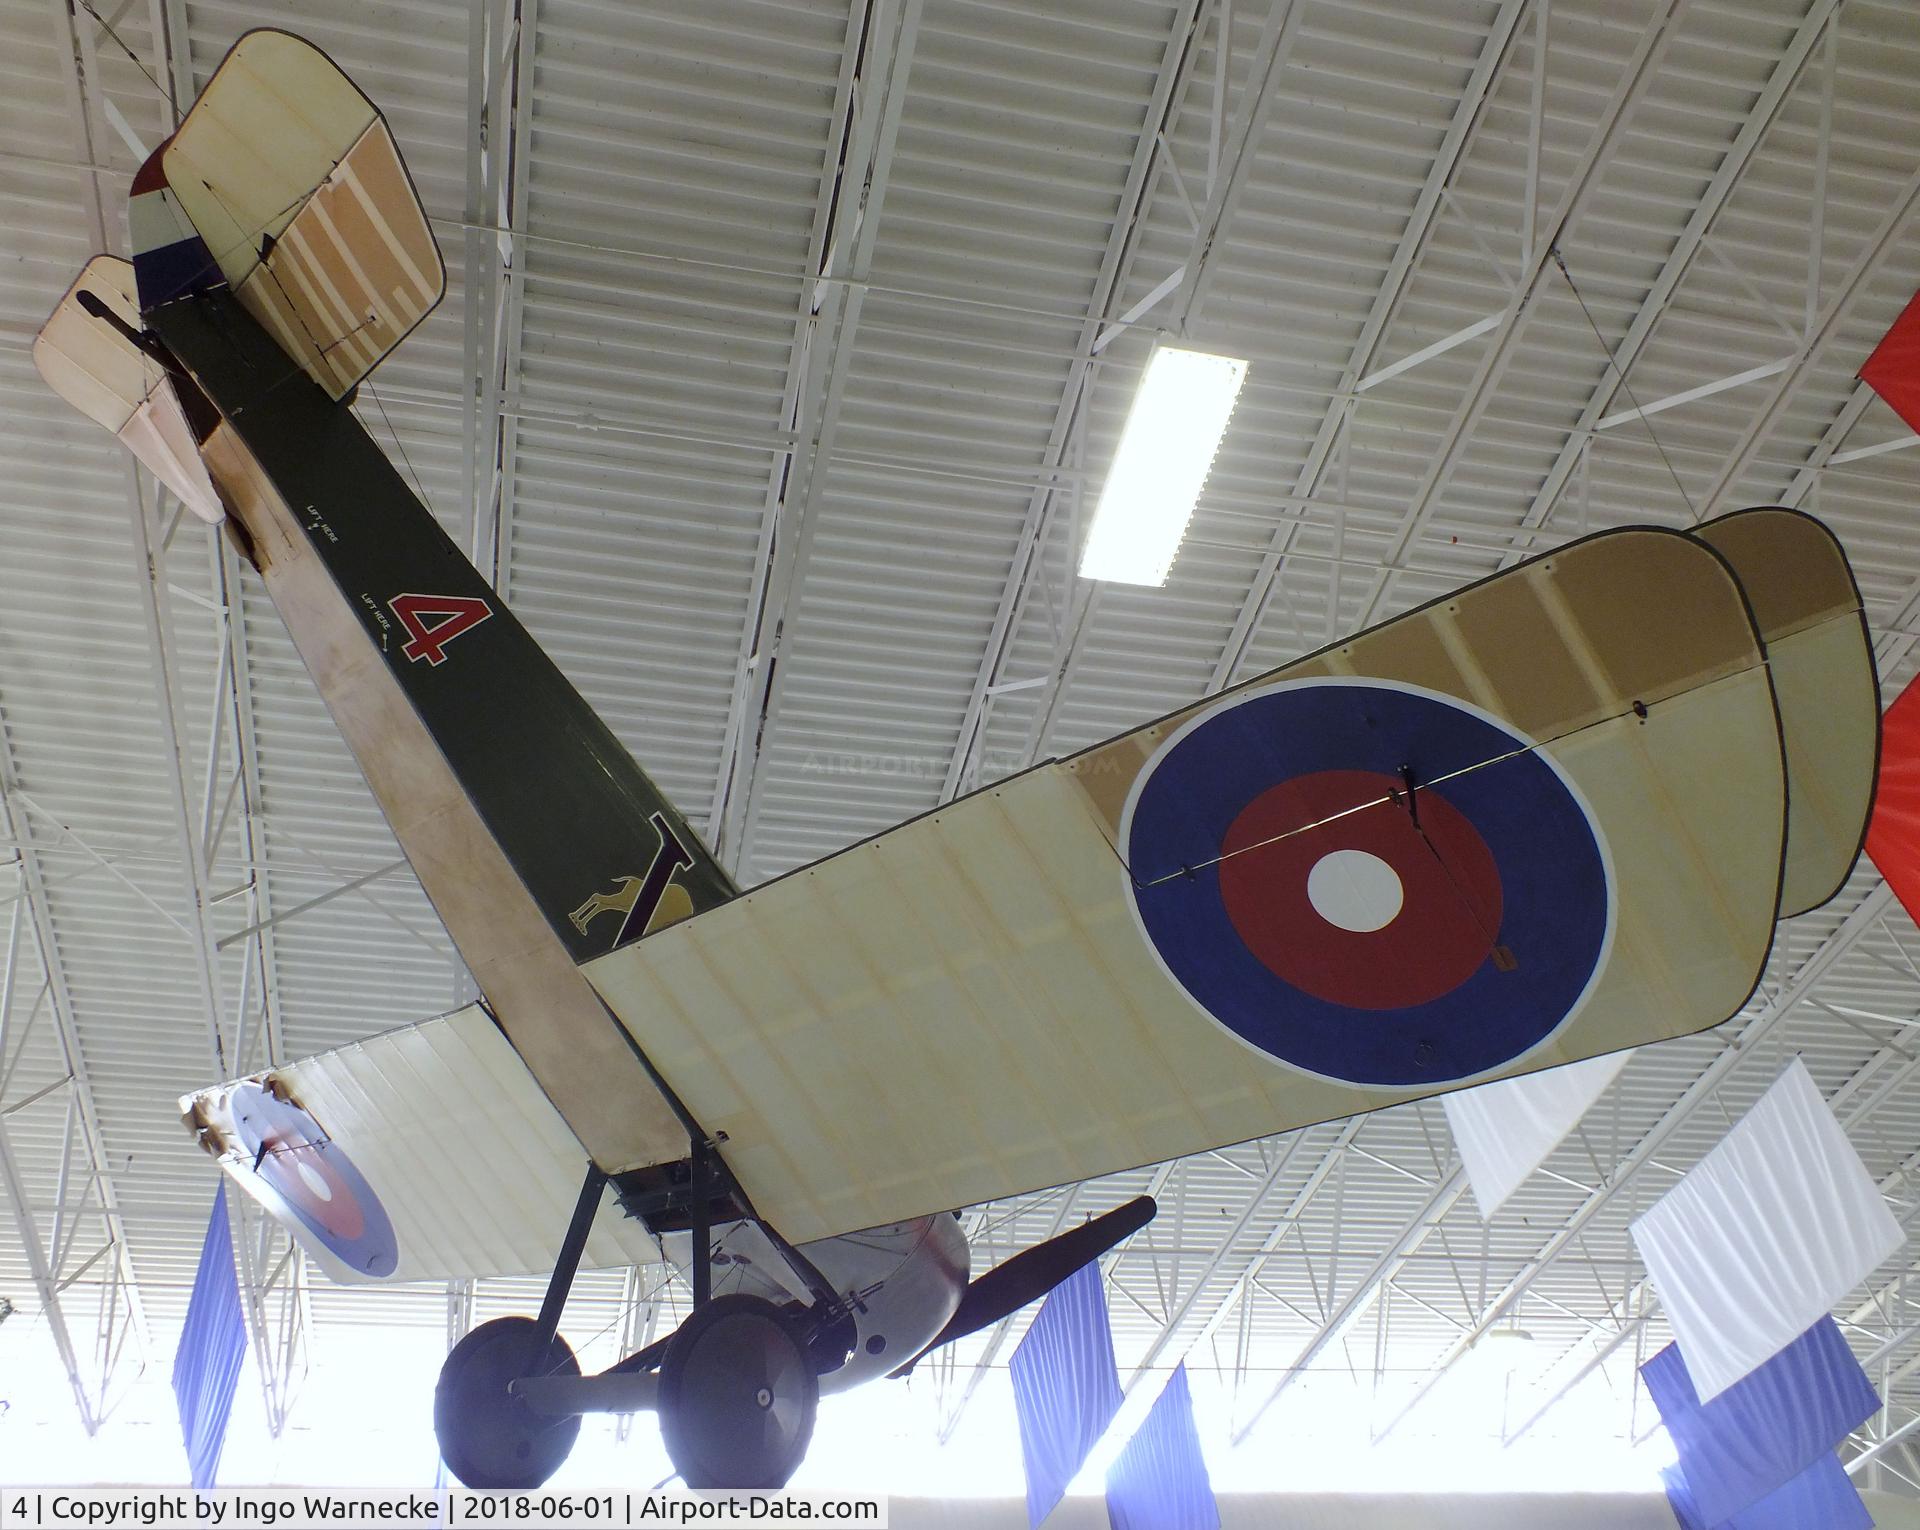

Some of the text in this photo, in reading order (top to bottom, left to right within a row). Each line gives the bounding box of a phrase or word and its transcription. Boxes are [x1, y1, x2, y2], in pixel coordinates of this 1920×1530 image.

[306, 504, 339, 544] LIFT HERE
[361, 592, 391, 631] LIFT HERE
[387, 592, 494, 667] 4
